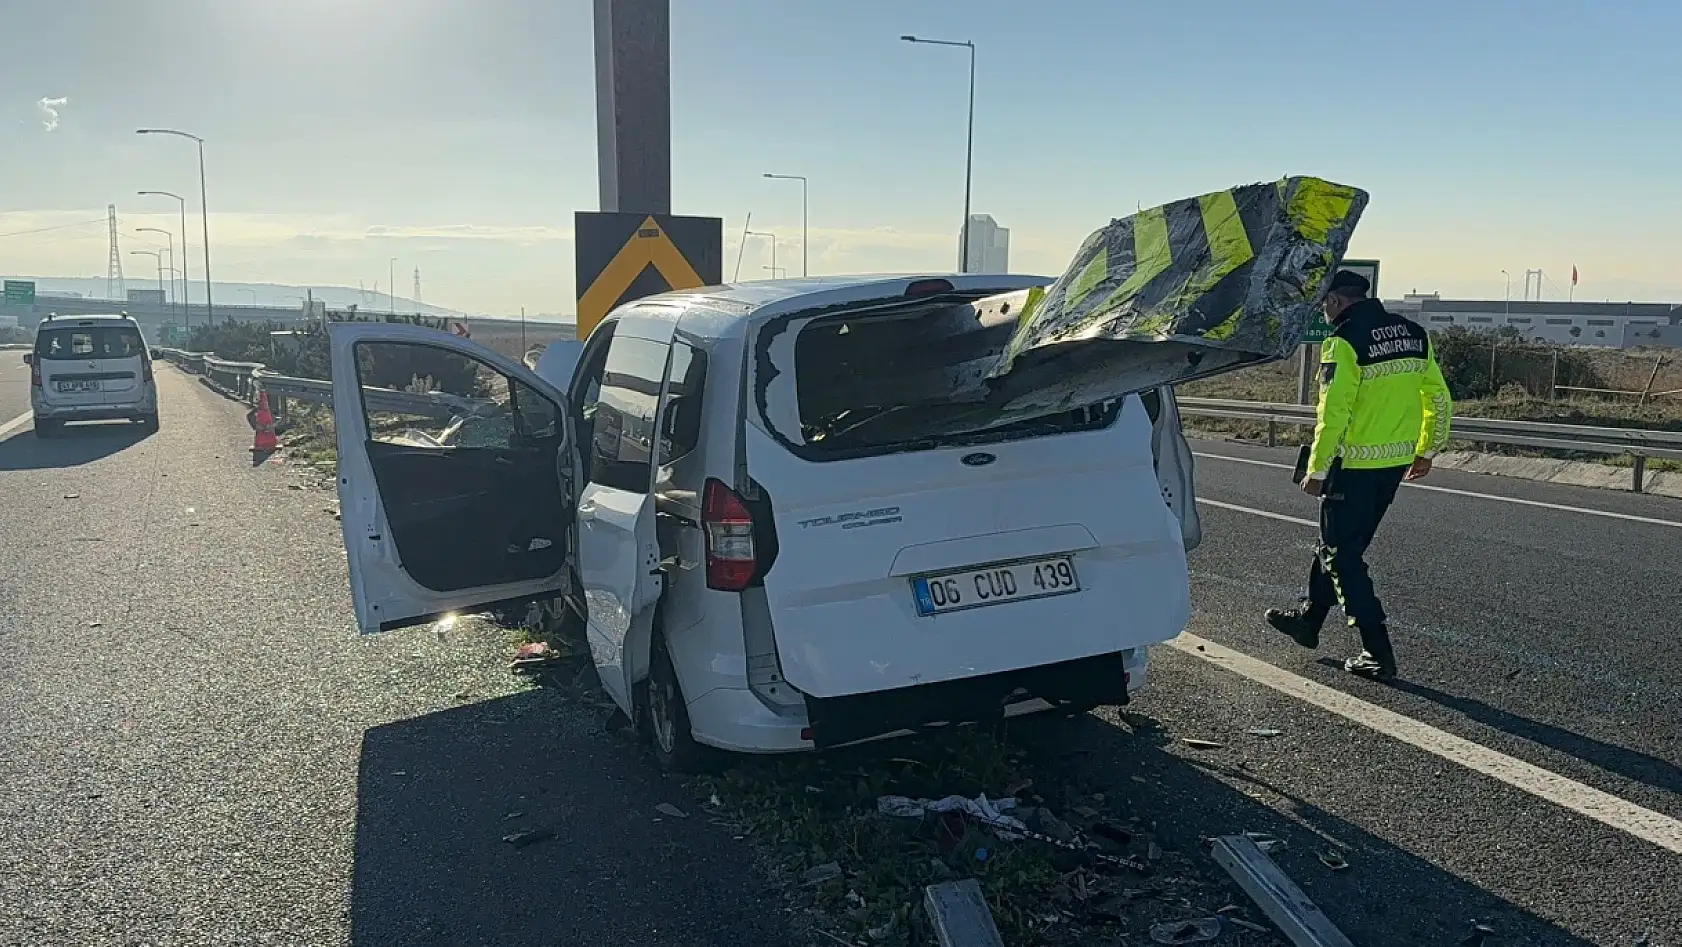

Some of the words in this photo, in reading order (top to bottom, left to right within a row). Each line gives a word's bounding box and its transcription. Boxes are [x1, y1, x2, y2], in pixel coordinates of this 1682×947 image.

[1371, 324, 1411, 341] OTOYOL
[1368, 338, 1423, 358] JANDARMASI
[797, 506, 900, 529] TOURNEO
[929, 579, 961, 607] 06
[973, 569, 1018, 600] CUD
[1033, 561, 1074, 590] 439
